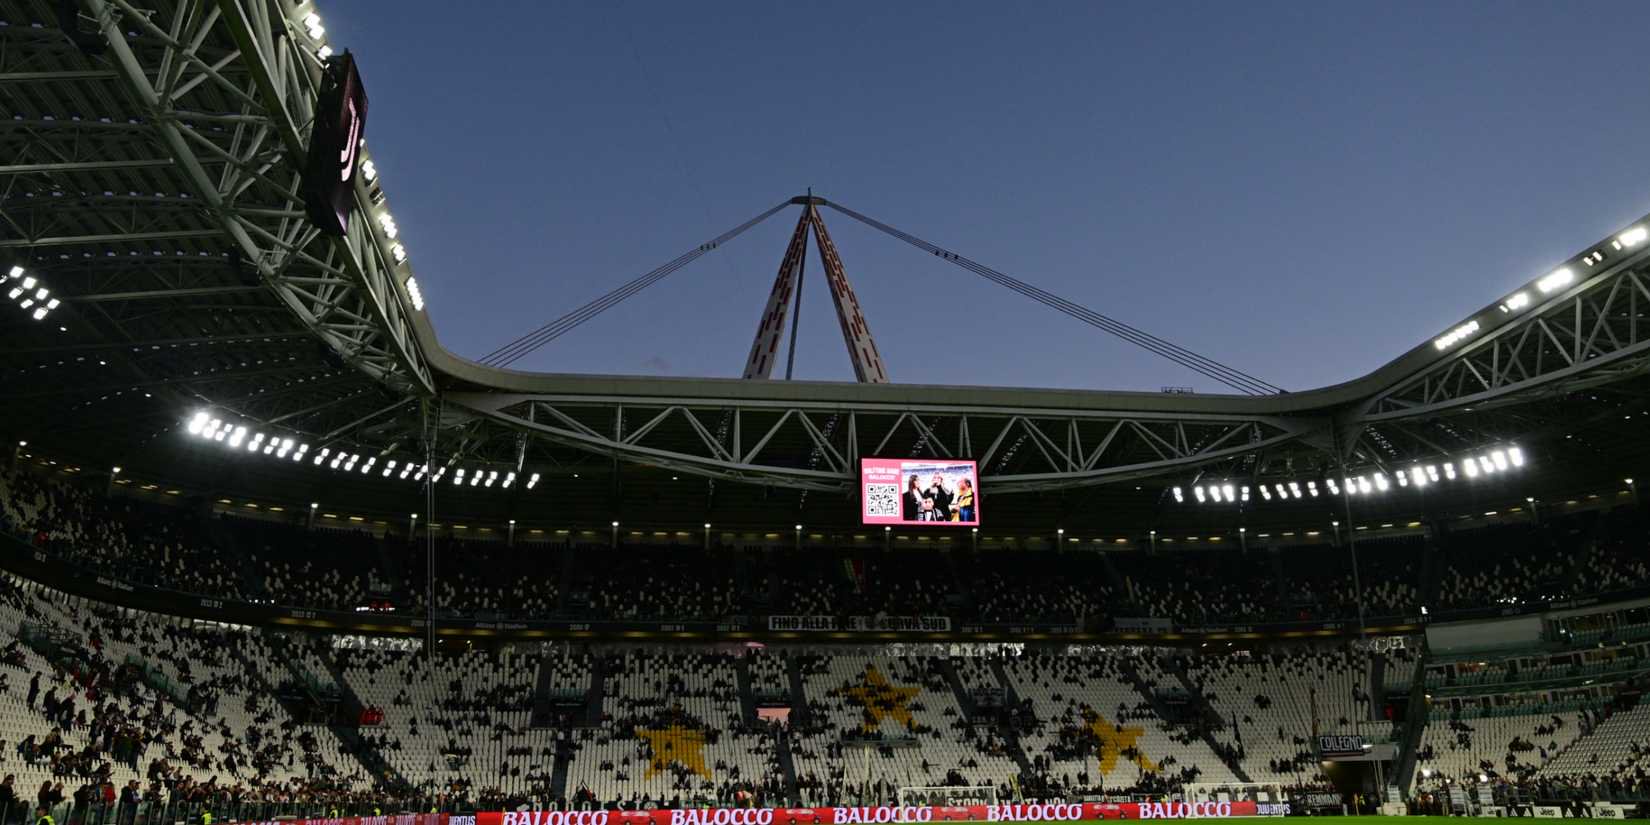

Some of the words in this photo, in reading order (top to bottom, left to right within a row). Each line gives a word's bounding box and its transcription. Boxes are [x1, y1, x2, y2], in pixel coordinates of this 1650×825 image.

[772, 617, 798, 629] FINO
[801, 617, 829, 629] ALLA
[922, 617, 945, 630] SUD
[1319, 735, 1363, 751] COLLEGNO
[671, 808, 774, 825] BALOCCO
[833, 806, 932, 823] BALOCCO
[986, 804, 1082, 820] BALOCCO
[1138, 801, 1231, 818] BALOCCO
[1539, 808, 1555, 816] Jeep
[1599, 809, 1615, 817] Jeep
[503, 811, 608, 825] BALOCCO
